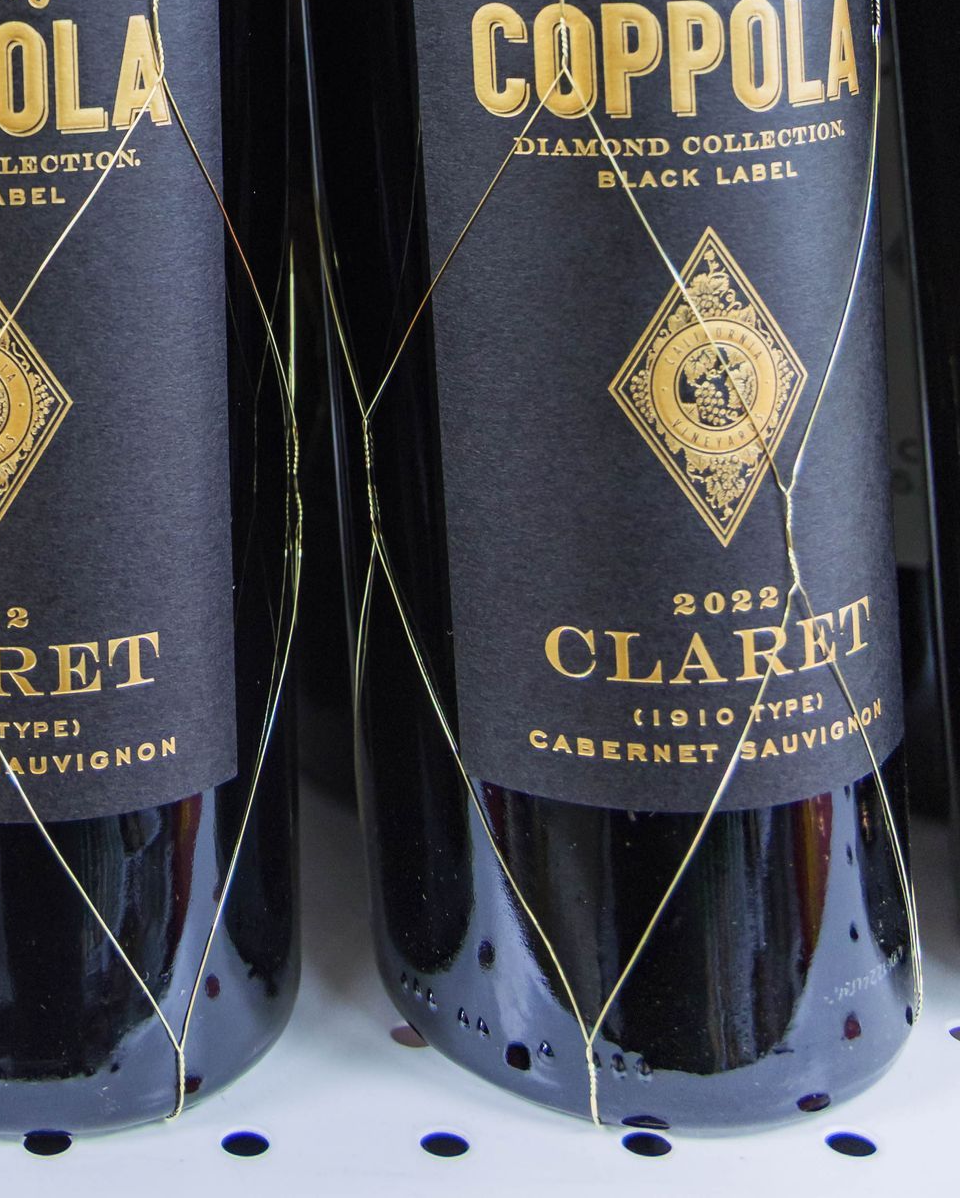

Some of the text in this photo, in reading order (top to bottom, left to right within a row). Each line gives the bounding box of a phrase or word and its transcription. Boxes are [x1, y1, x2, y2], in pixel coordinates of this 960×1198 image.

[513, 137, 670, 158] DIAMOND
[598, 161, 798, 189] BLACK LABEL
[671, 411, 764, 448] VINEYARDS
[673, 586, 779, 616] 2022
[544, 595, 871, 685] CLARET
[633, 692, 824, 727] (1910 TYPE)
[529, 698, 882, 763] CABERNET SAUVIGNON
